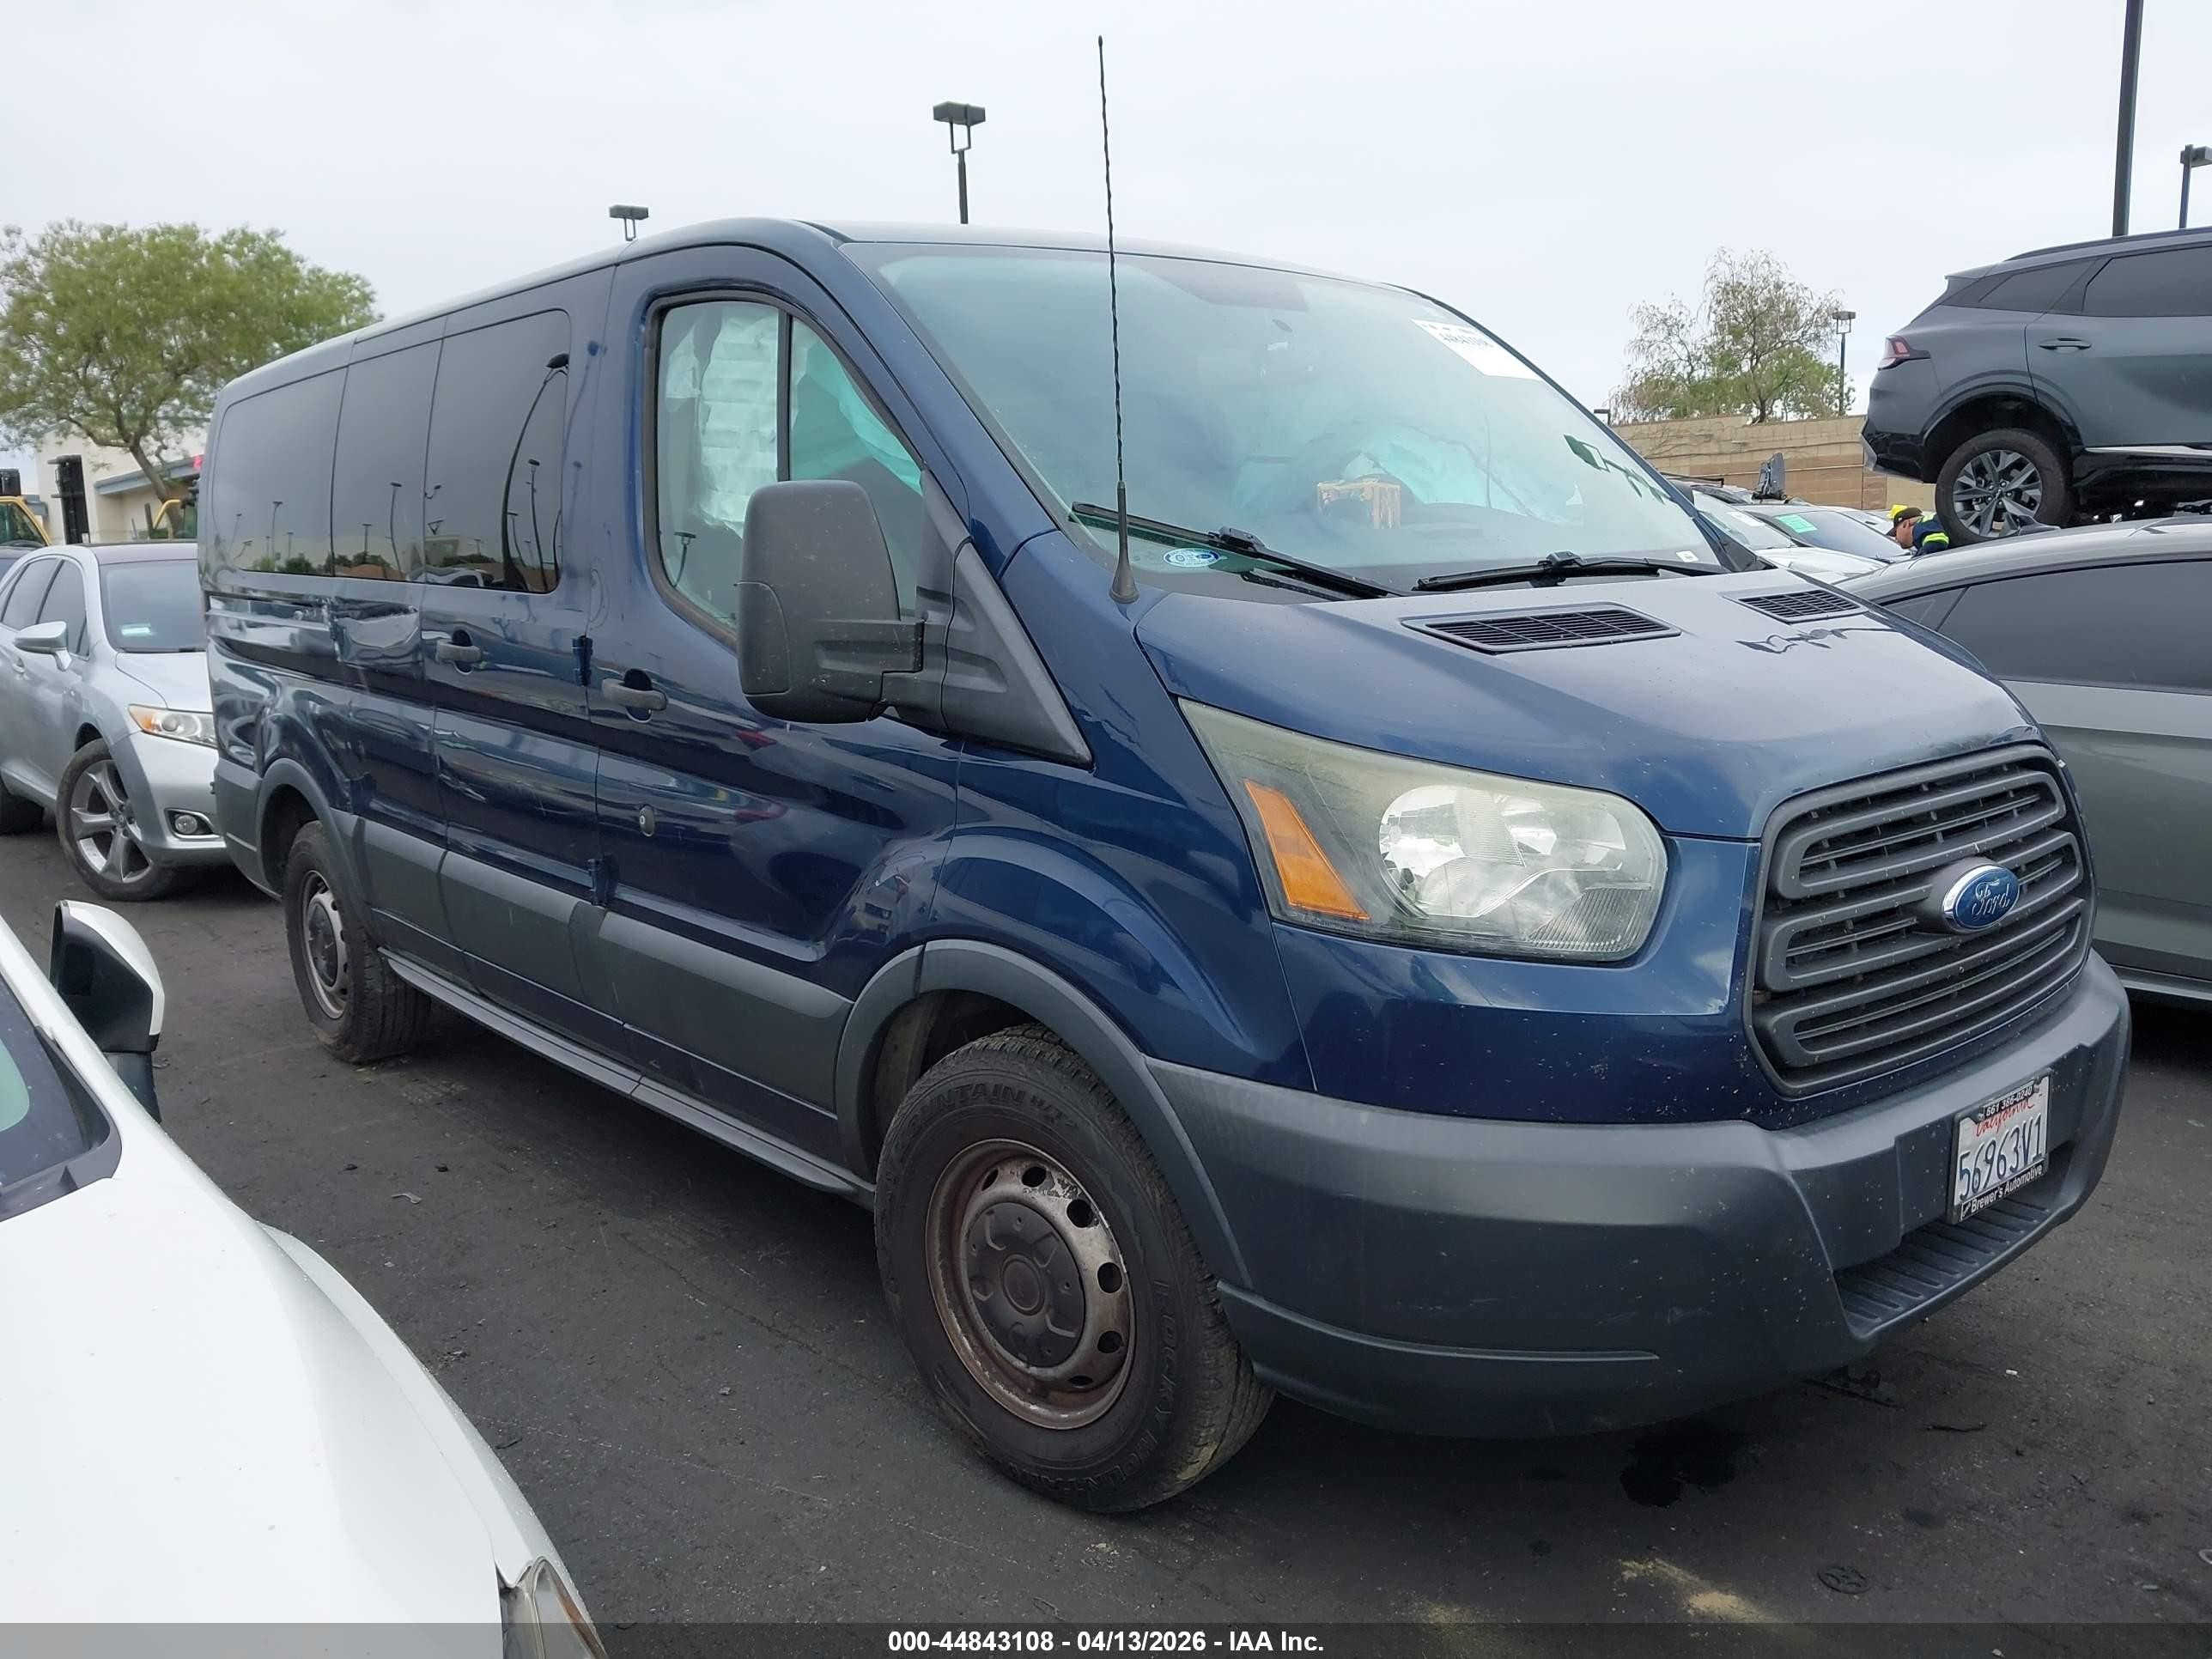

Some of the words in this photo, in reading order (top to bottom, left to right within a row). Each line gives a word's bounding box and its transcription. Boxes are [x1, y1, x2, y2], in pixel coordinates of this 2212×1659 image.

[1972, 878, 2010, 919] Ford
[1958, 1113, 2043, 1201] 56963V1
[1970, 1185, 2004, 1213] Brewer's
[2004, 1163, 2043, 1194] Automotive
